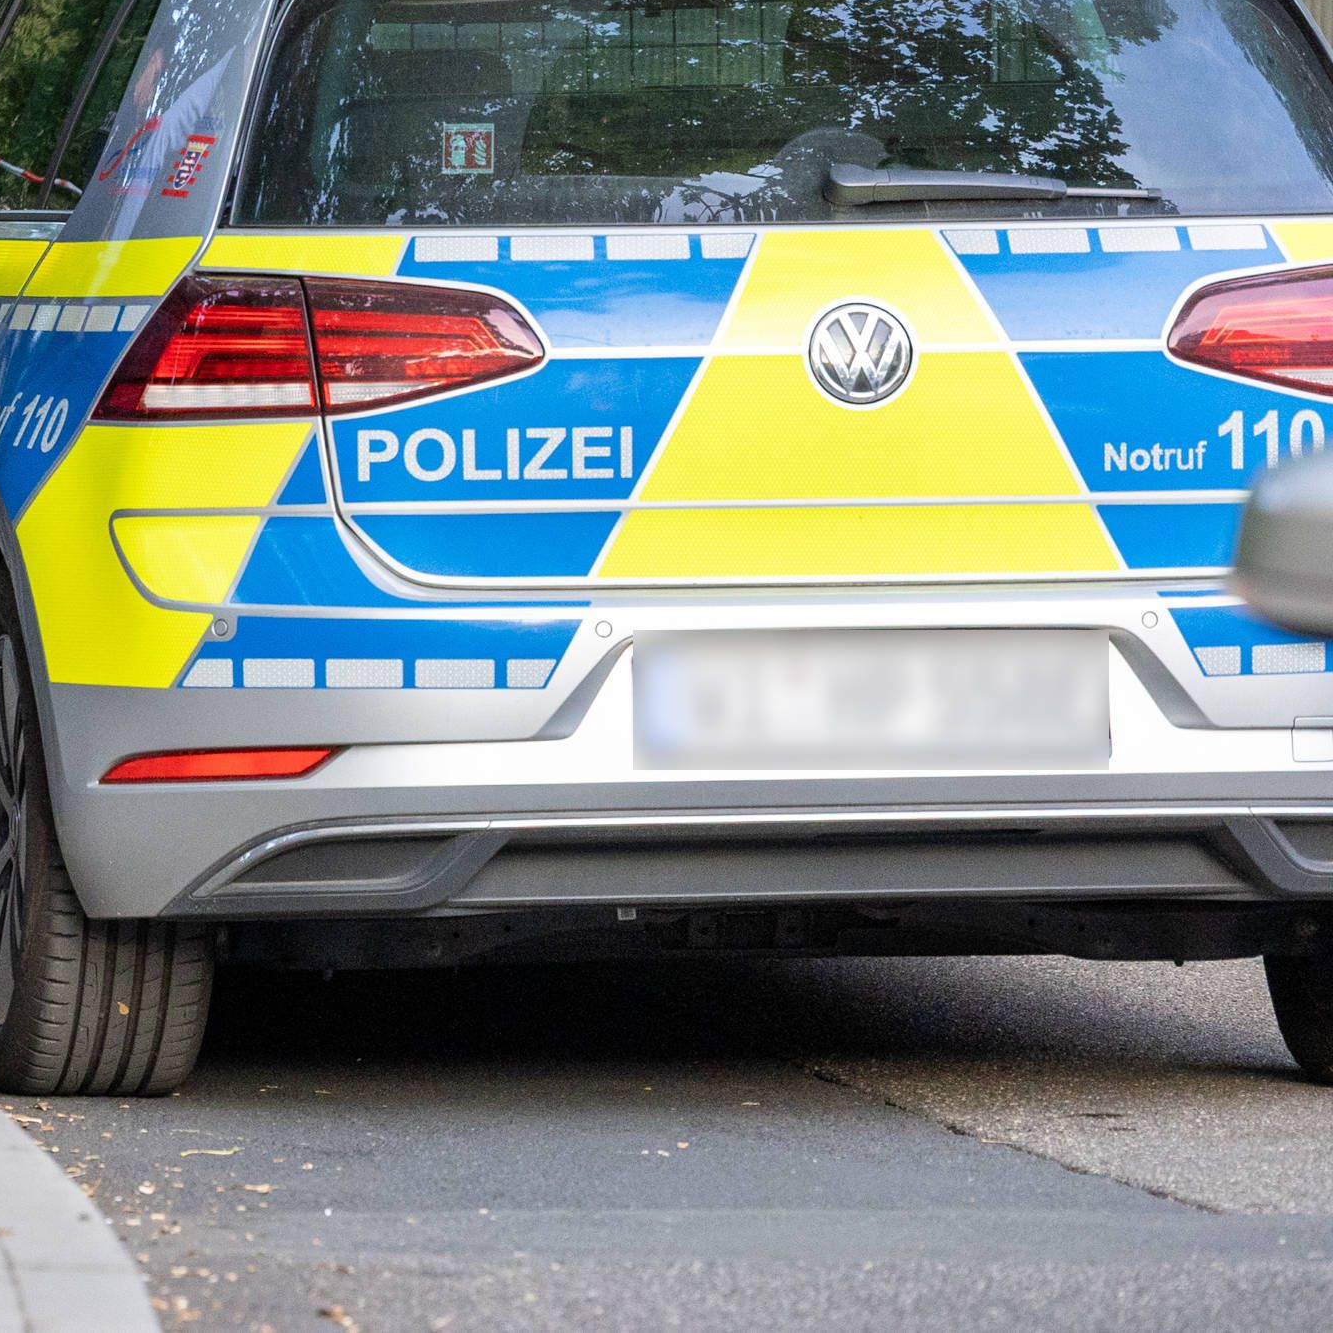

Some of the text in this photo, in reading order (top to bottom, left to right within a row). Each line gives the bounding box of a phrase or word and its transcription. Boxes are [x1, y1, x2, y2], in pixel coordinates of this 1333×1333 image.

[13, 394, 69, 453] 110
[1103, 409, 1325, 472] Notruf 110
[357, 426, 633, 482] POLIZEI
